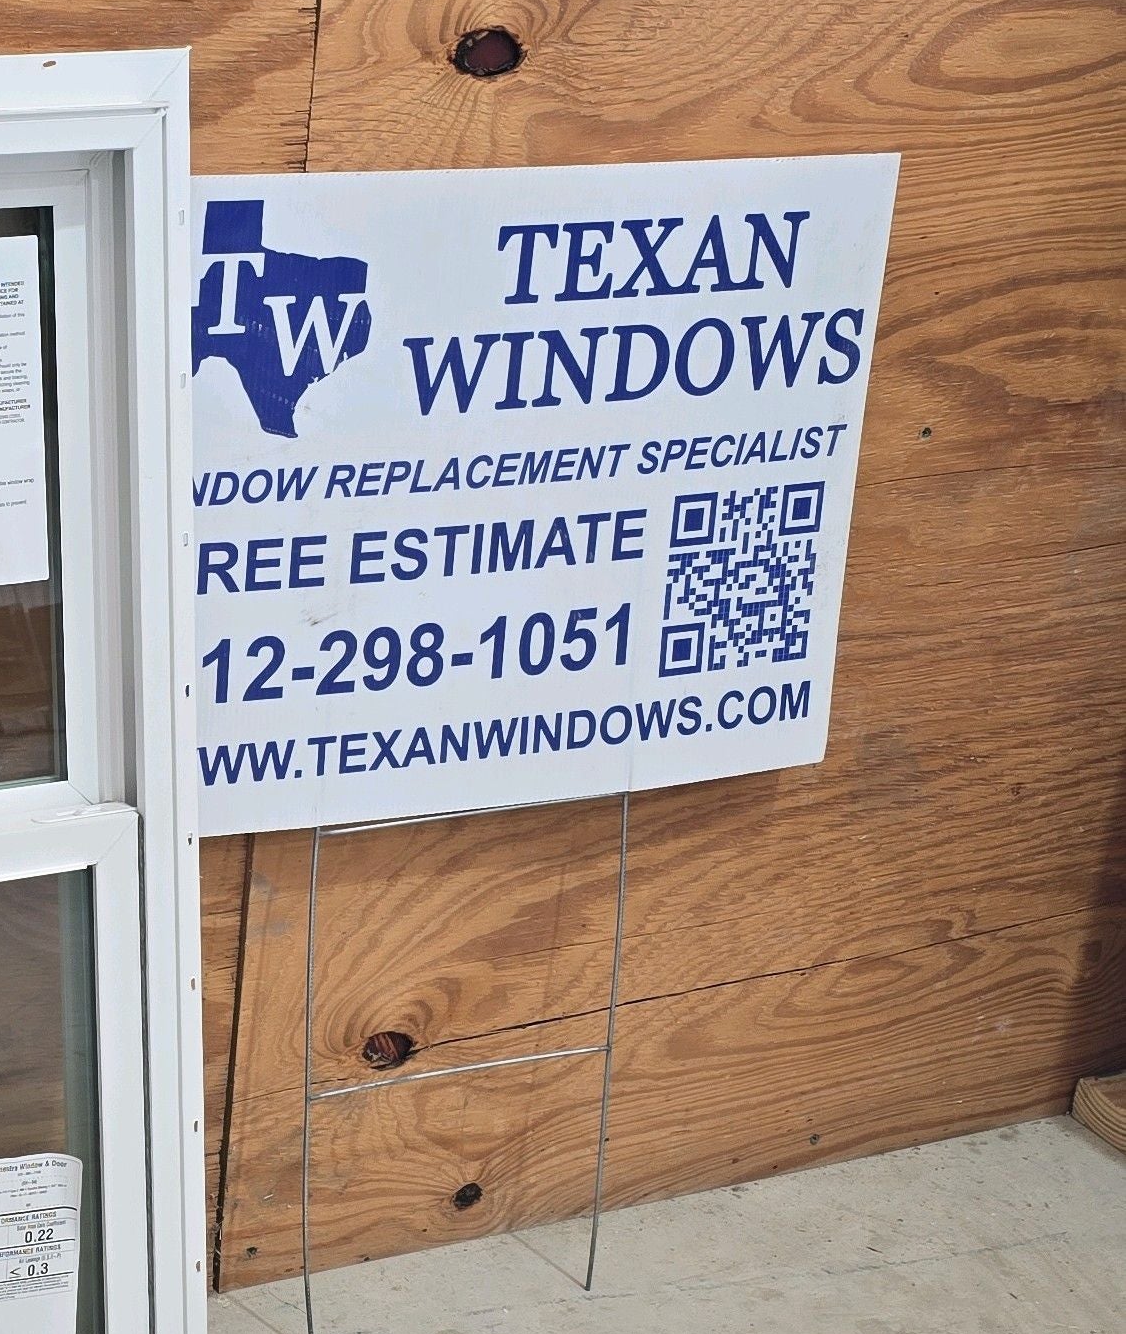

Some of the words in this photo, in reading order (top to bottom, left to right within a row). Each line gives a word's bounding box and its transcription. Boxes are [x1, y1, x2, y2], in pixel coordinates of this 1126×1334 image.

[497, 211, 810, 304] TEXAN
[403, 308, 864, 416] WINDOWS
[193, 466, 319, 506] NDOW
[324, 443, 631, 499] REPLACEMENT
[637, 424, 847, 475] SPECIALIST
[196, 535, 327, 595] REE
[350, 509, 647, 584] ESTIMATE
[202, 603, 631, 703] 12-298-1051
[196, 680, 811, 786] WW.TEXANWINDOWS.COM
[20, 1161, 42, 1170] Window
[51, 1159, 67, 1169] Door
[25, 1228, 53, 1243] 0.22
[32, 1211, 56, 1220] RATINGS
[36, 1244, 61, 1252] RATINGS
[28, 1262, 49, 1276] 0.3
